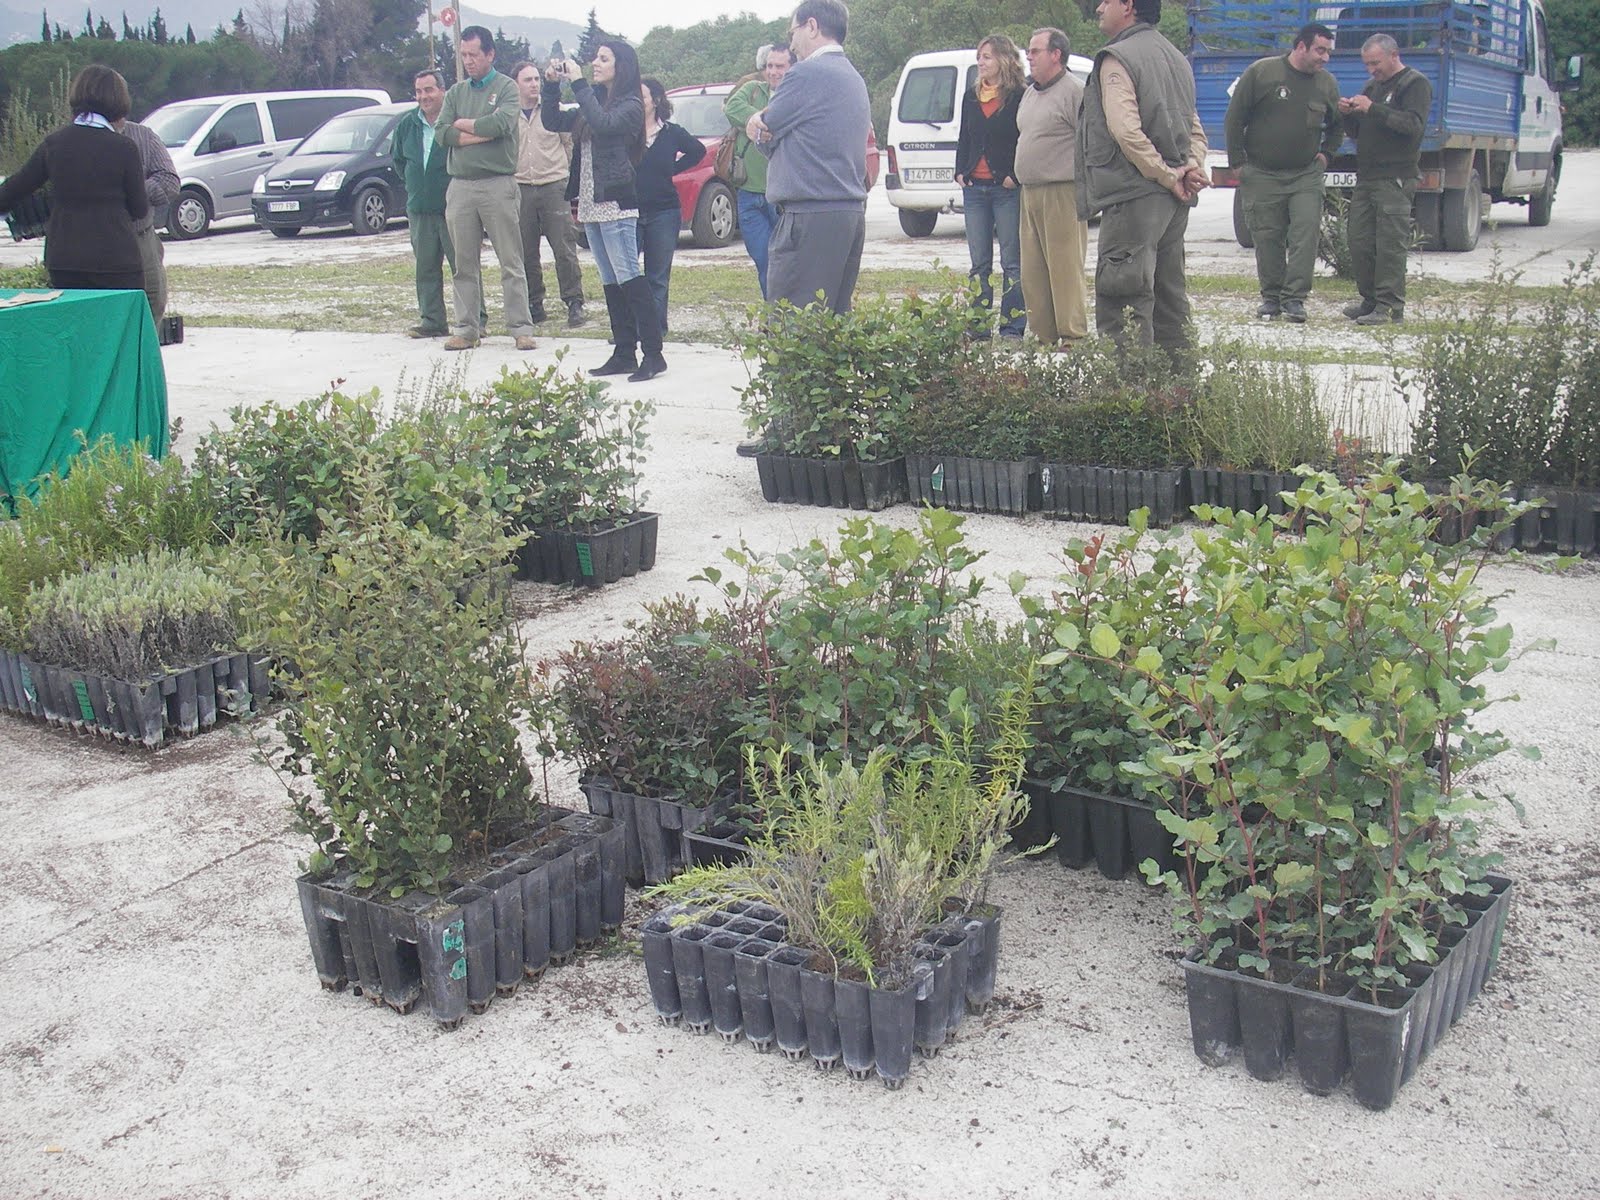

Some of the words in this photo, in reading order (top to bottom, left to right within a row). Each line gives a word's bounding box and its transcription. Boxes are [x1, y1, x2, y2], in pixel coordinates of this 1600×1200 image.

[911, 170, 933, 180] 1471
[935, 170, 951, 180] BRC
[1333, 174, 1354, 185] DJG
